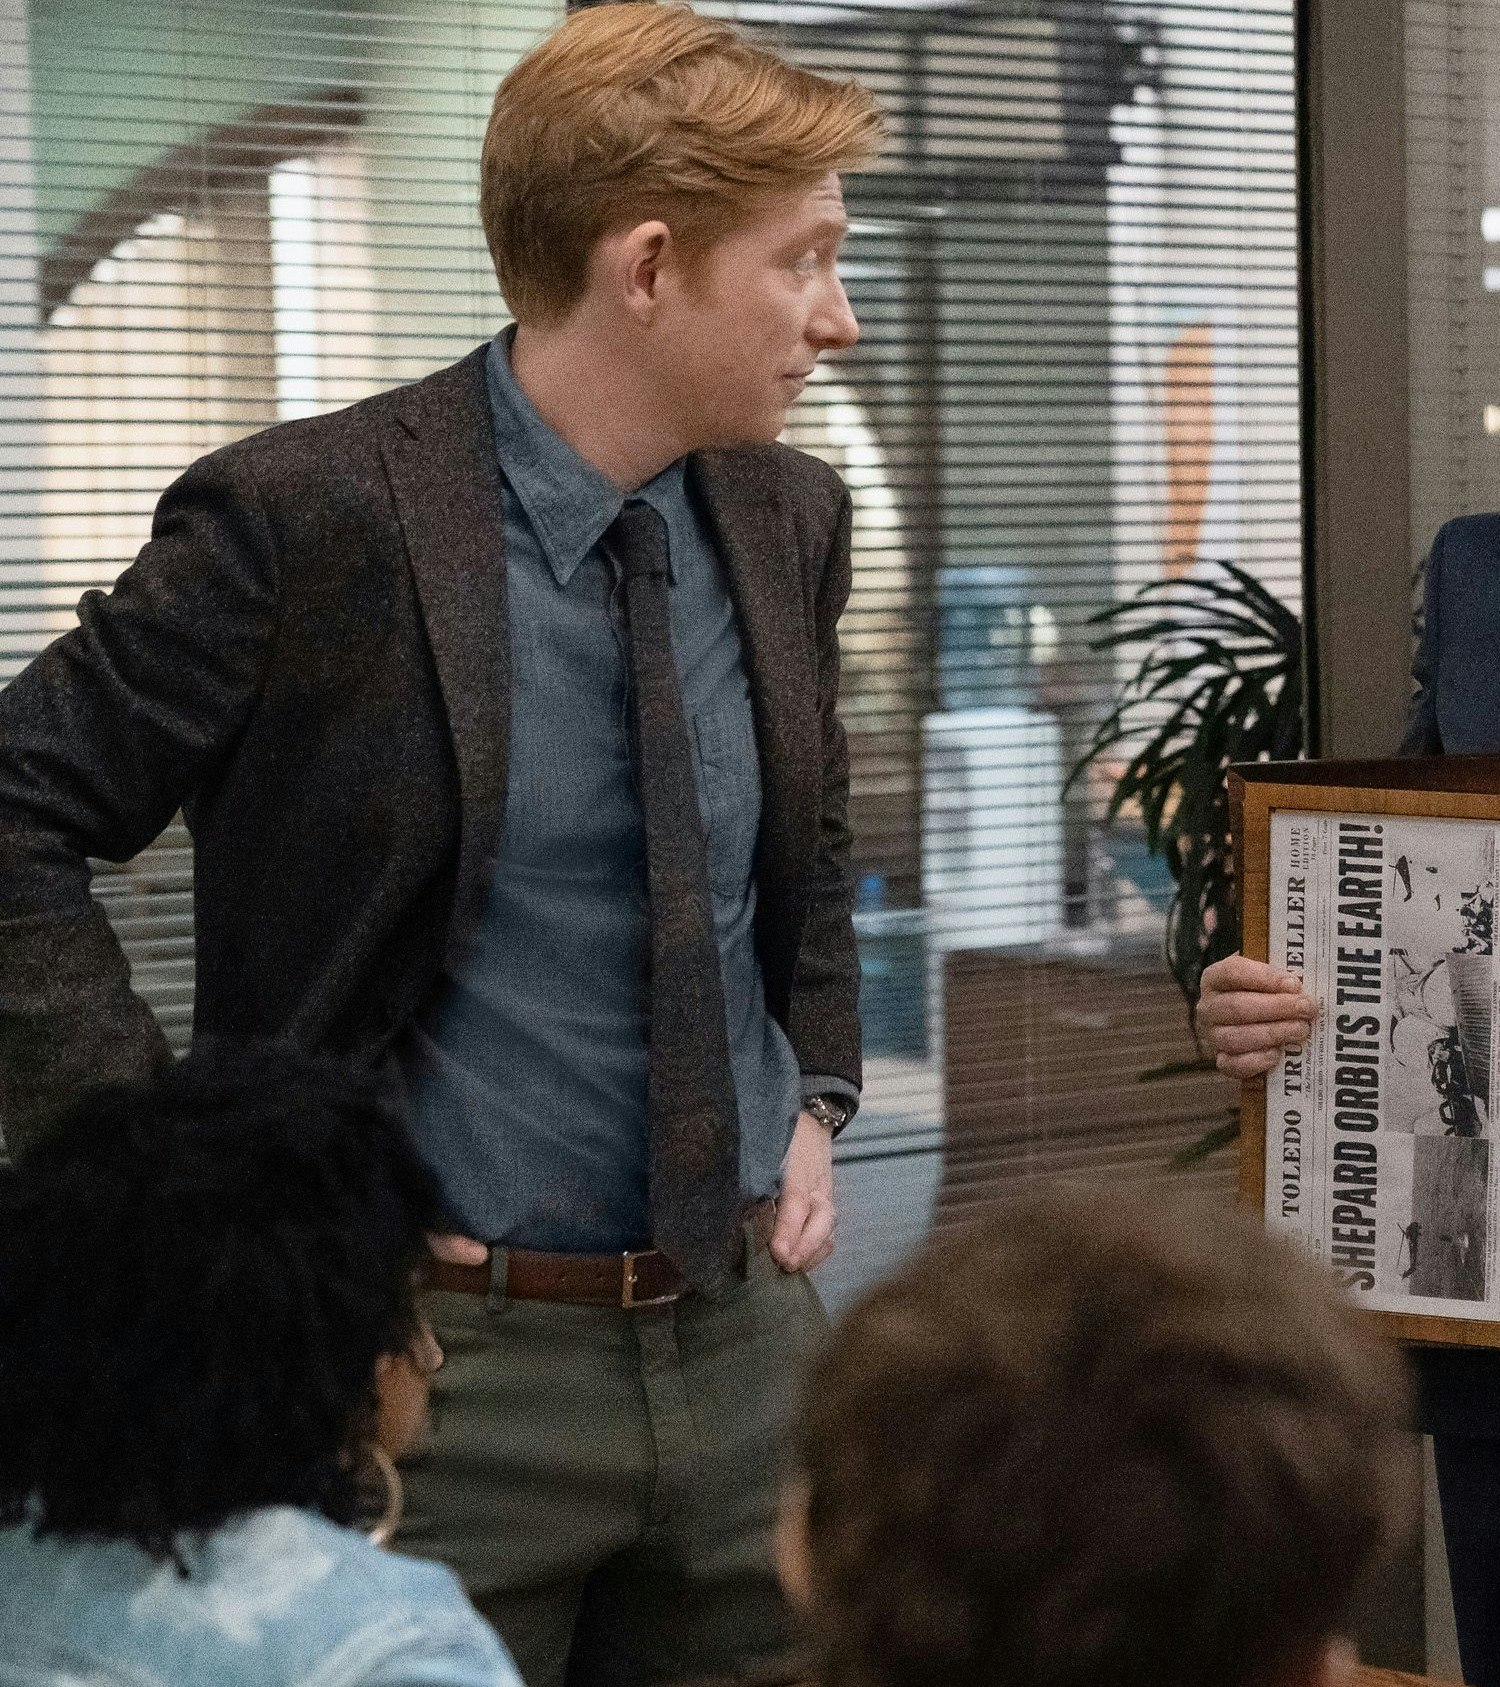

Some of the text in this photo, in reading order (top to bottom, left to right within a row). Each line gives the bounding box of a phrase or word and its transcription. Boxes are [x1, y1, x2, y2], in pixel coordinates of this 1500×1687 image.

[1290, 827, 1301, 869] HOME
[1332, 822, 1384, 1291] SHEPARD ORBITS THE EARTH!
[1282, 1110, 1301, 1218] TOLEDO
